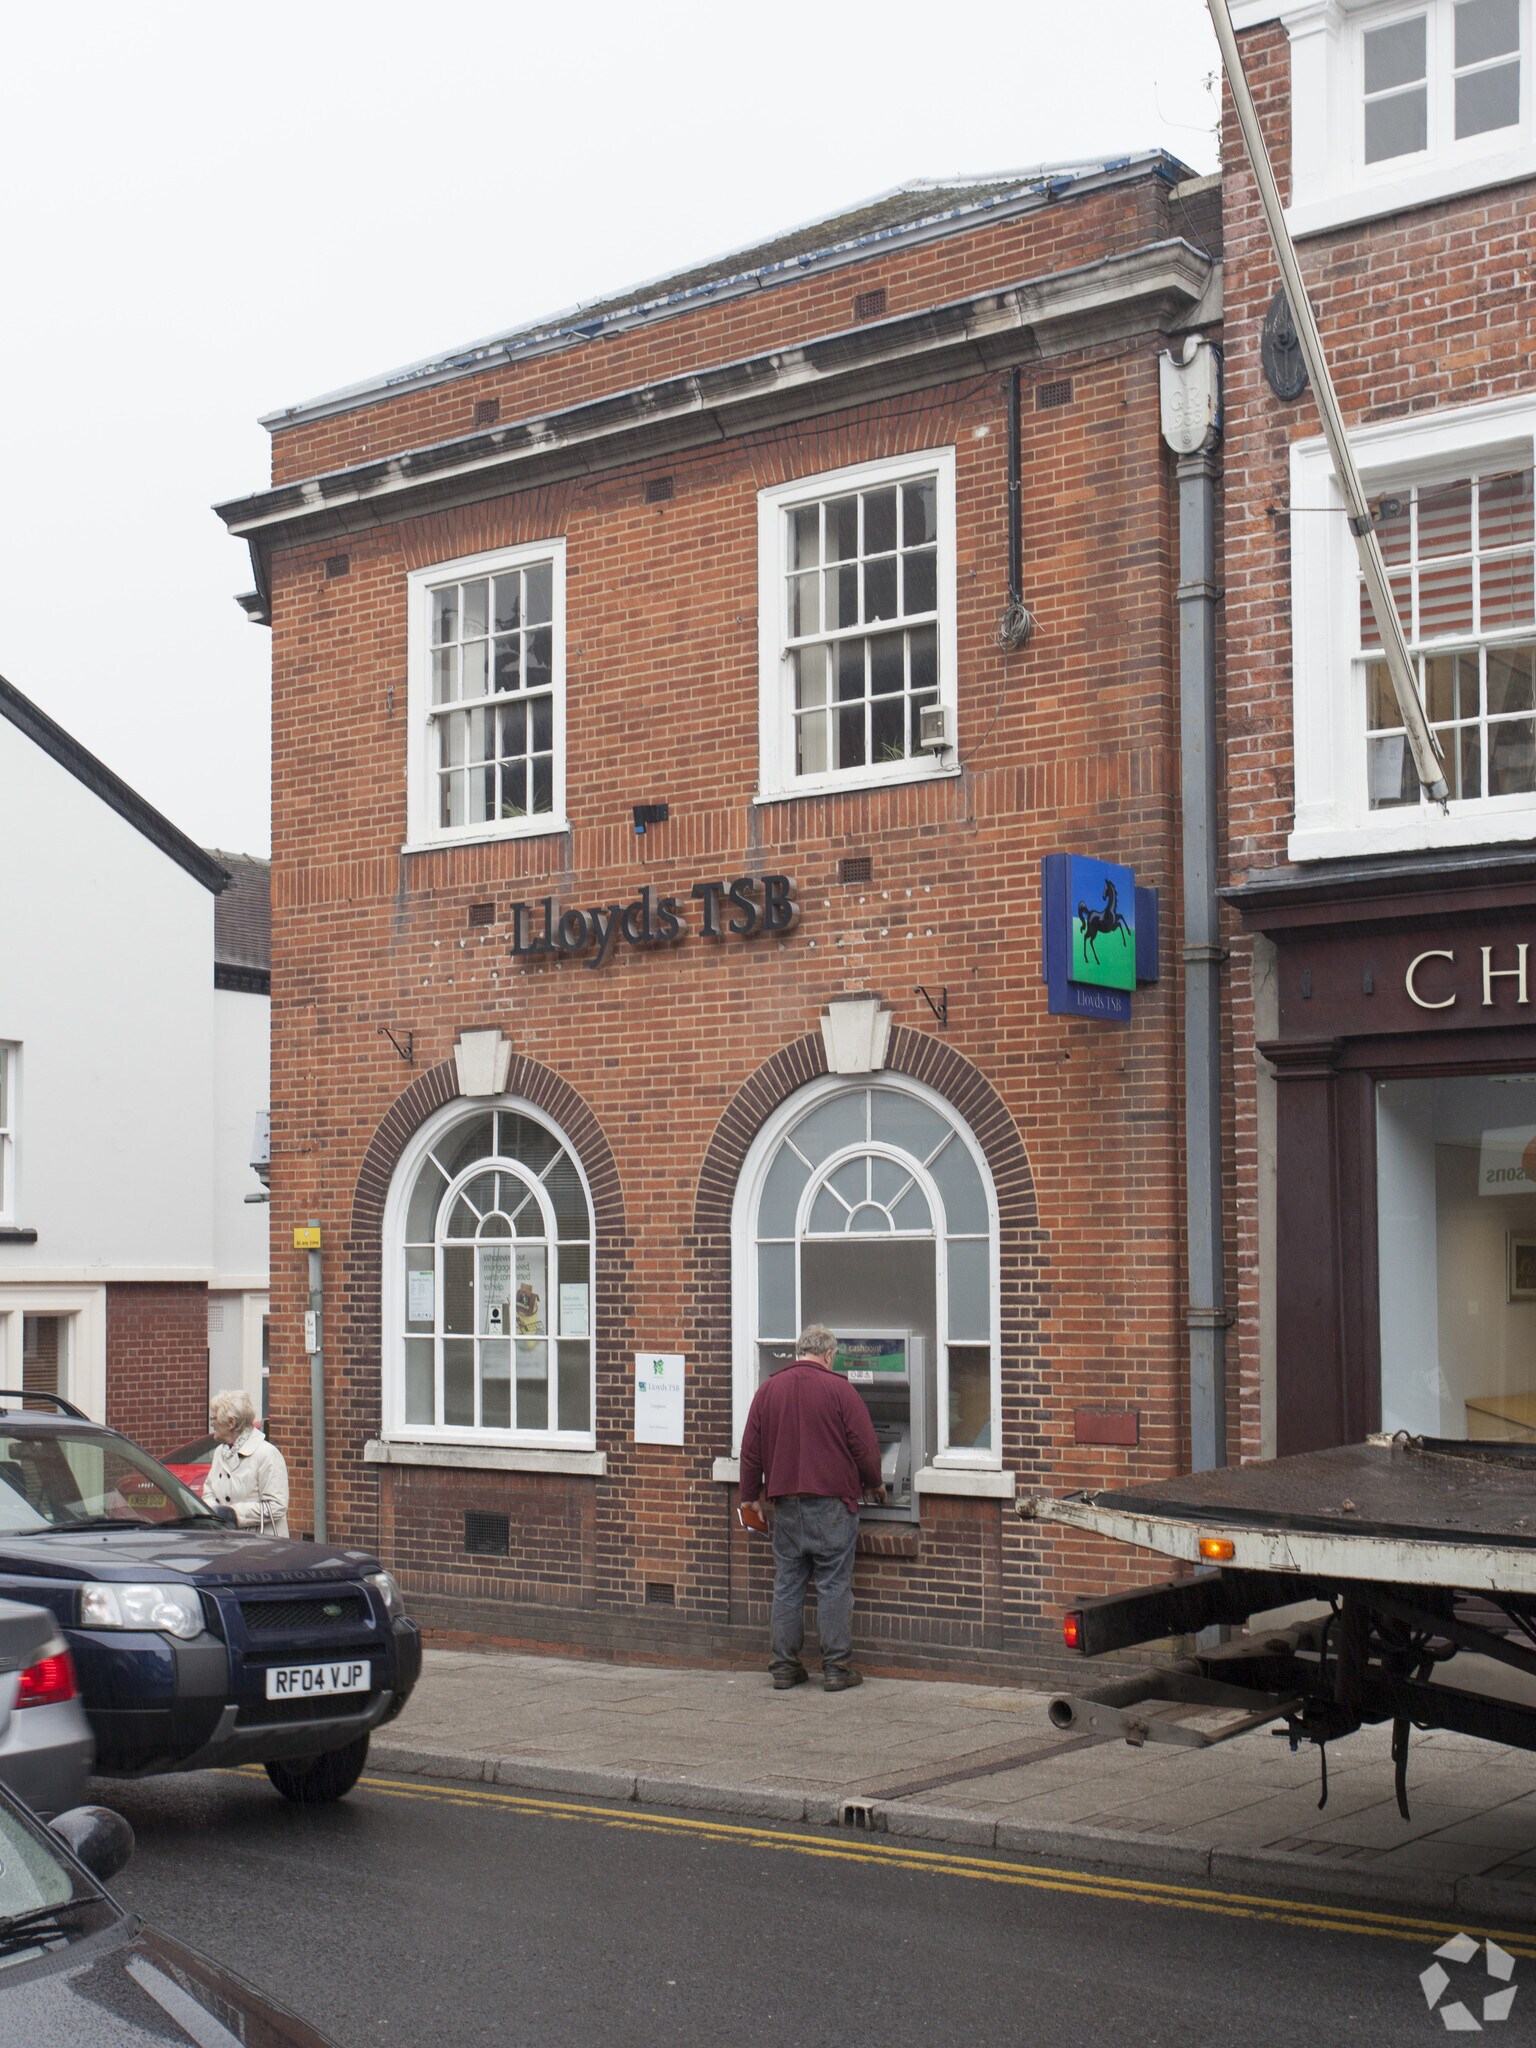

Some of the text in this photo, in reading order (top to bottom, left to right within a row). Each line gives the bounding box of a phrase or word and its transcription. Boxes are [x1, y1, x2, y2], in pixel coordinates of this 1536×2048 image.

[510, 875, 798, 969] Lloyds TSB
[1405, 943, 1530, 1009] CH
[1077, 990, 1122, 1012] Lloyds TSB
[848, 1343, 882, 1353] cashpoint
[649, 1382, 680, 1392] Lloyds TSB
[216, 1569, 343, 1583] LAND ROVER
[276, 1664, 362, 1693] RF04 VJP
